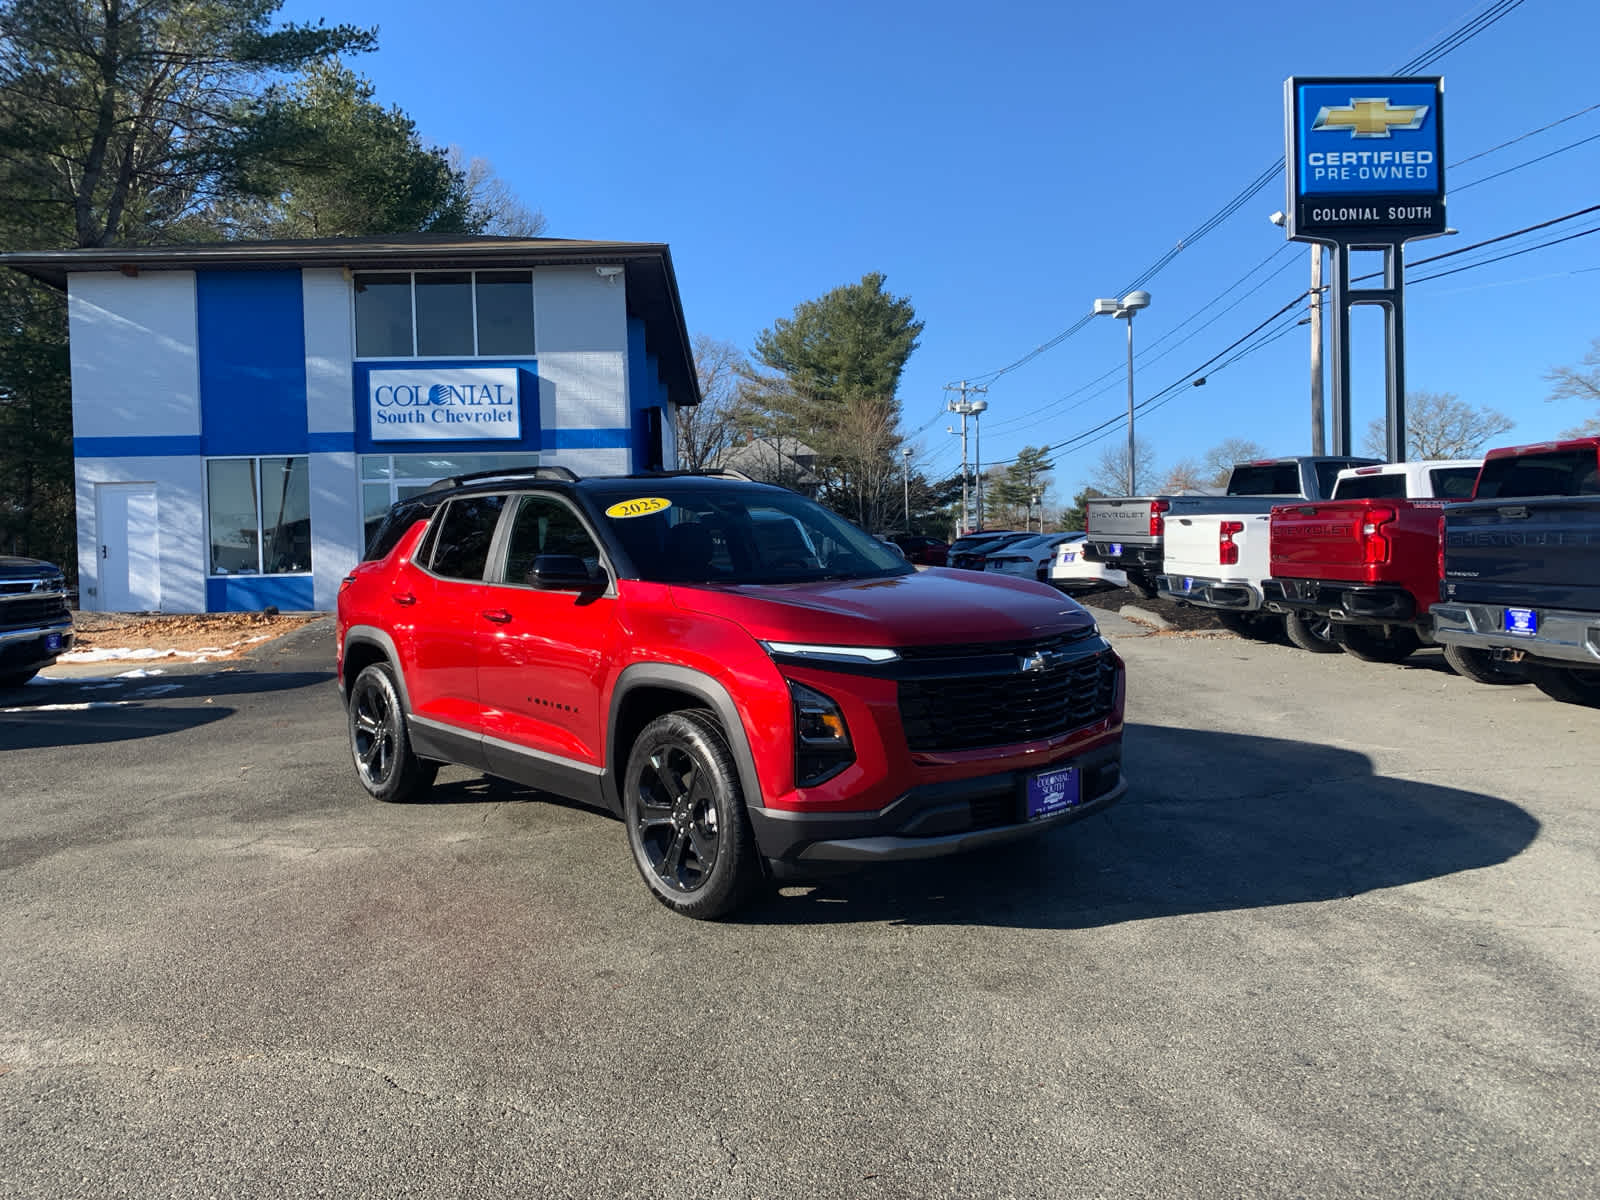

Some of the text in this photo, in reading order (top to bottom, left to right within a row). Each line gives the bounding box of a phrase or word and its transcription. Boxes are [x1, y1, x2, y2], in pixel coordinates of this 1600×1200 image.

[1308, 151, 1433, 166] CERTIFIED
[1315, 166, 1428, 180] PRE-OWNED
[1312, 206, 1432, 221] COLONIAL SOUTH
[375, 384, 512, 407] COLONIAL
[377, 408, 513, 424] South Chevrolet
[620, 499, 661, 516] 2025
[1091, 511, 1145, 520] CHEVROLET
[1042, 782, 1065, 794] SOUTH
